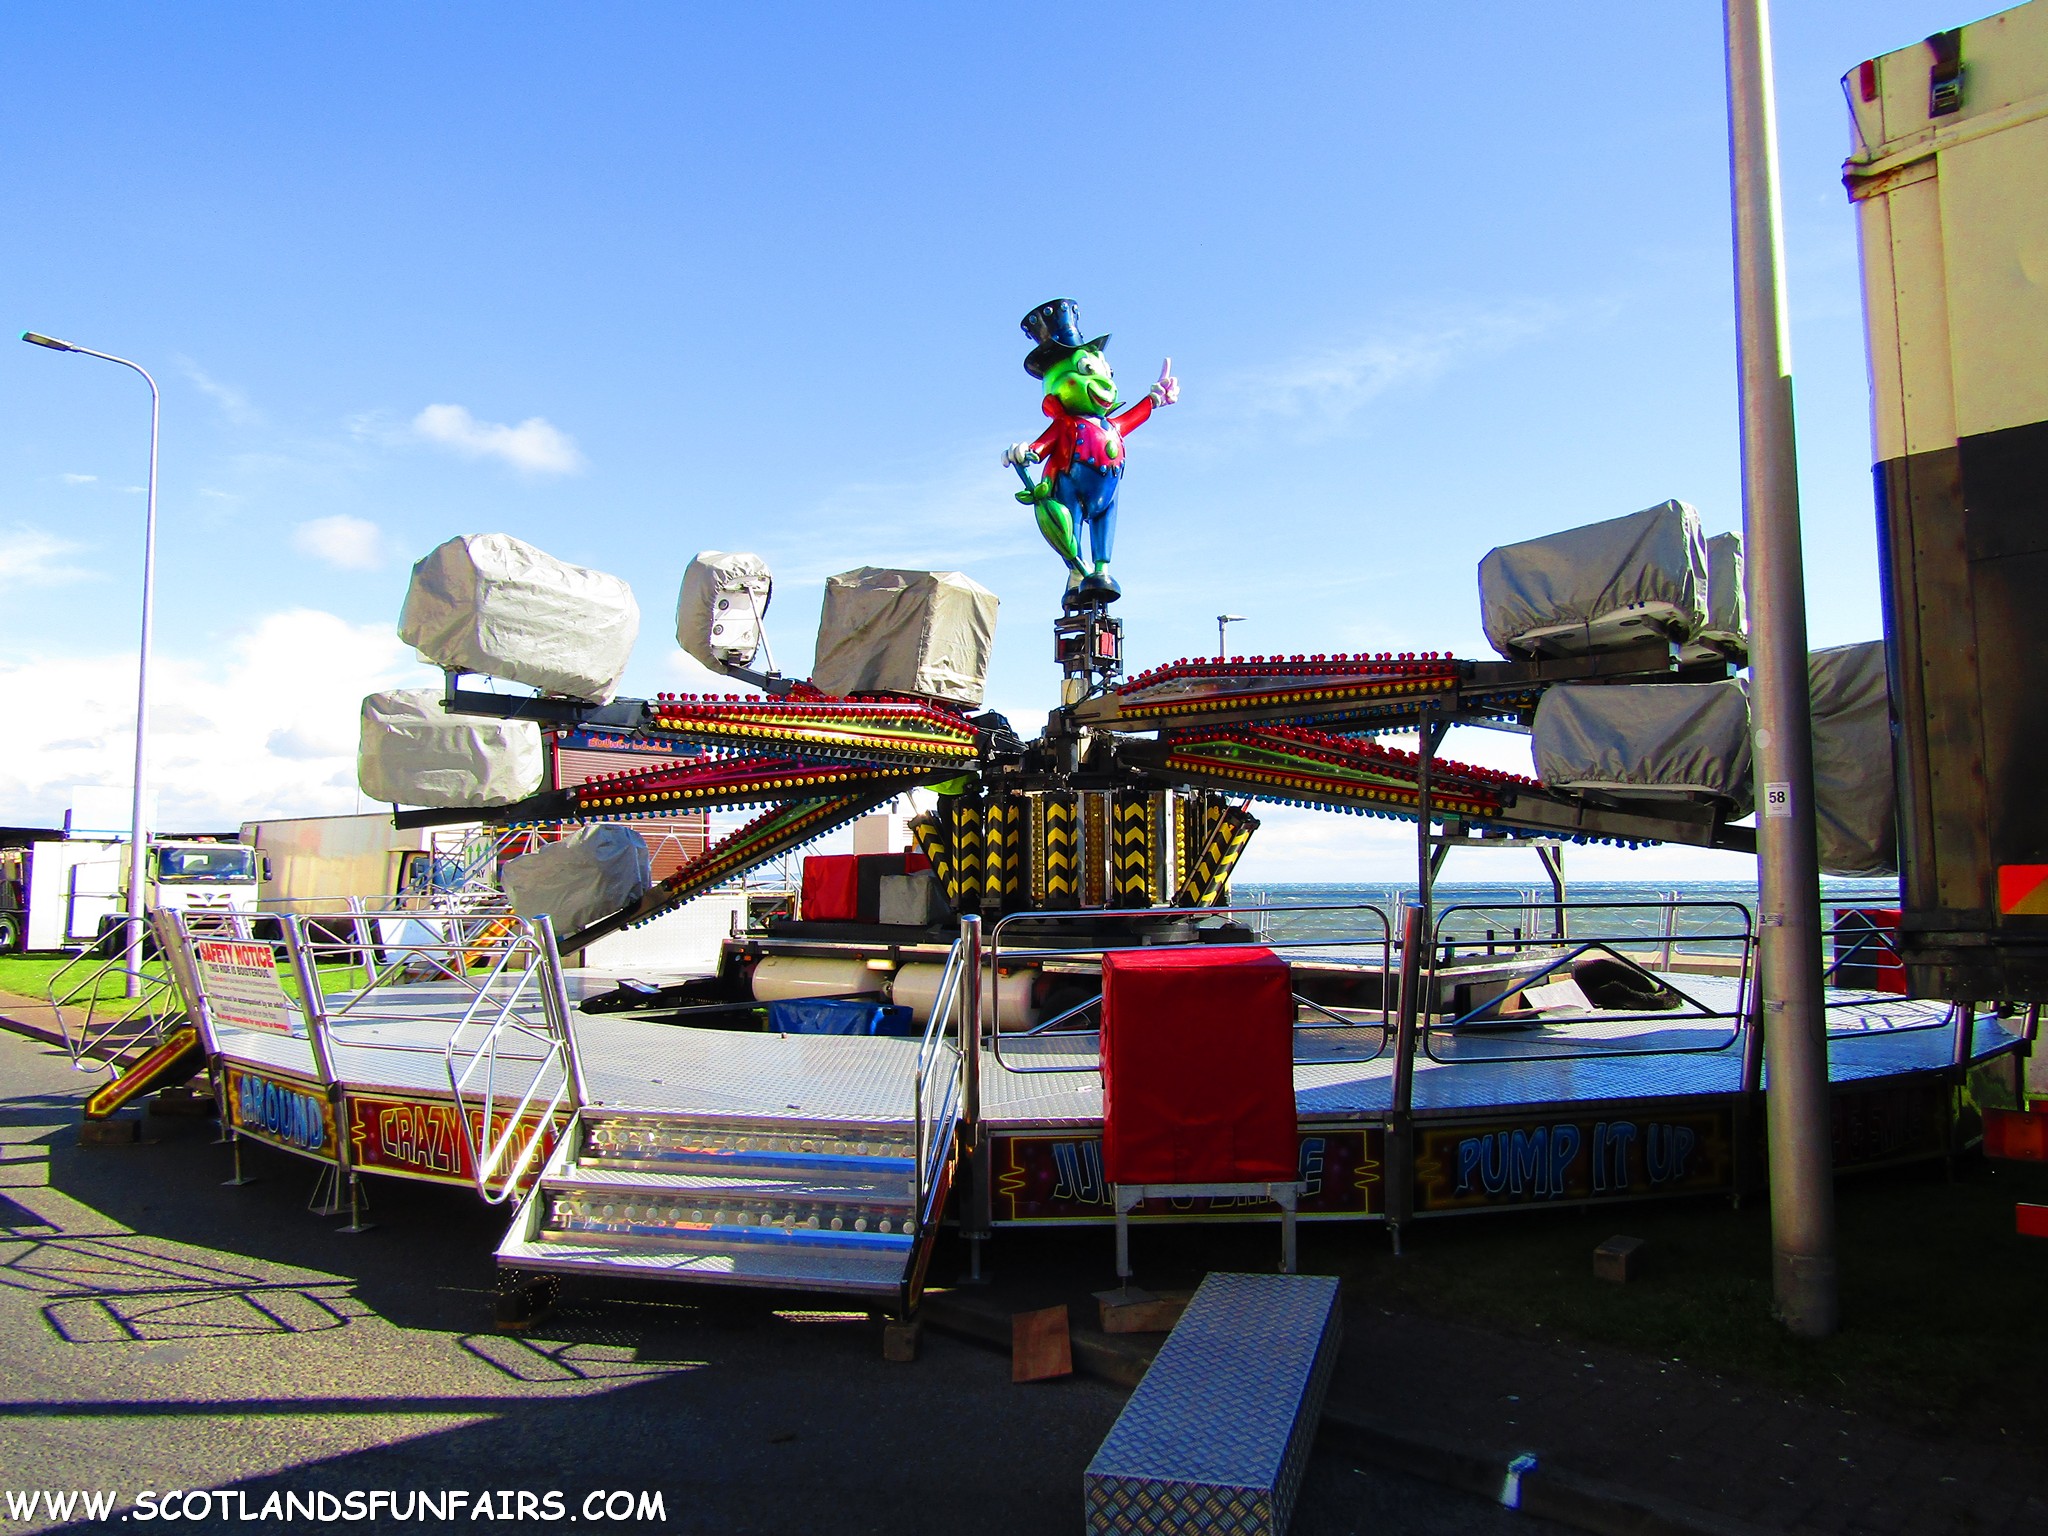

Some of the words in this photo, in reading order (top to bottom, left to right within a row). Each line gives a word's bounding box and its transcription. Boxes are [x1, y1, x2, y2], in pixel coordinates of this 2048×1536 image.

[1769, 791, 1785, 803] 58
[200, 942, 234, 964] SAFETY
[234, 945, 274, 968] NOTICE
[219, 964, 230, 974] RIDE
[231, 966, 236, 975] IS
[241, 1073, 324, 1150] AROUND
[379, 1106, 464, 1174] CRAZY
[1454, 1123, 1581, 1196] PUMP
[1592, 1121, 1638, 1191] IT
[1646, 1123, 1696, 1184] UP
